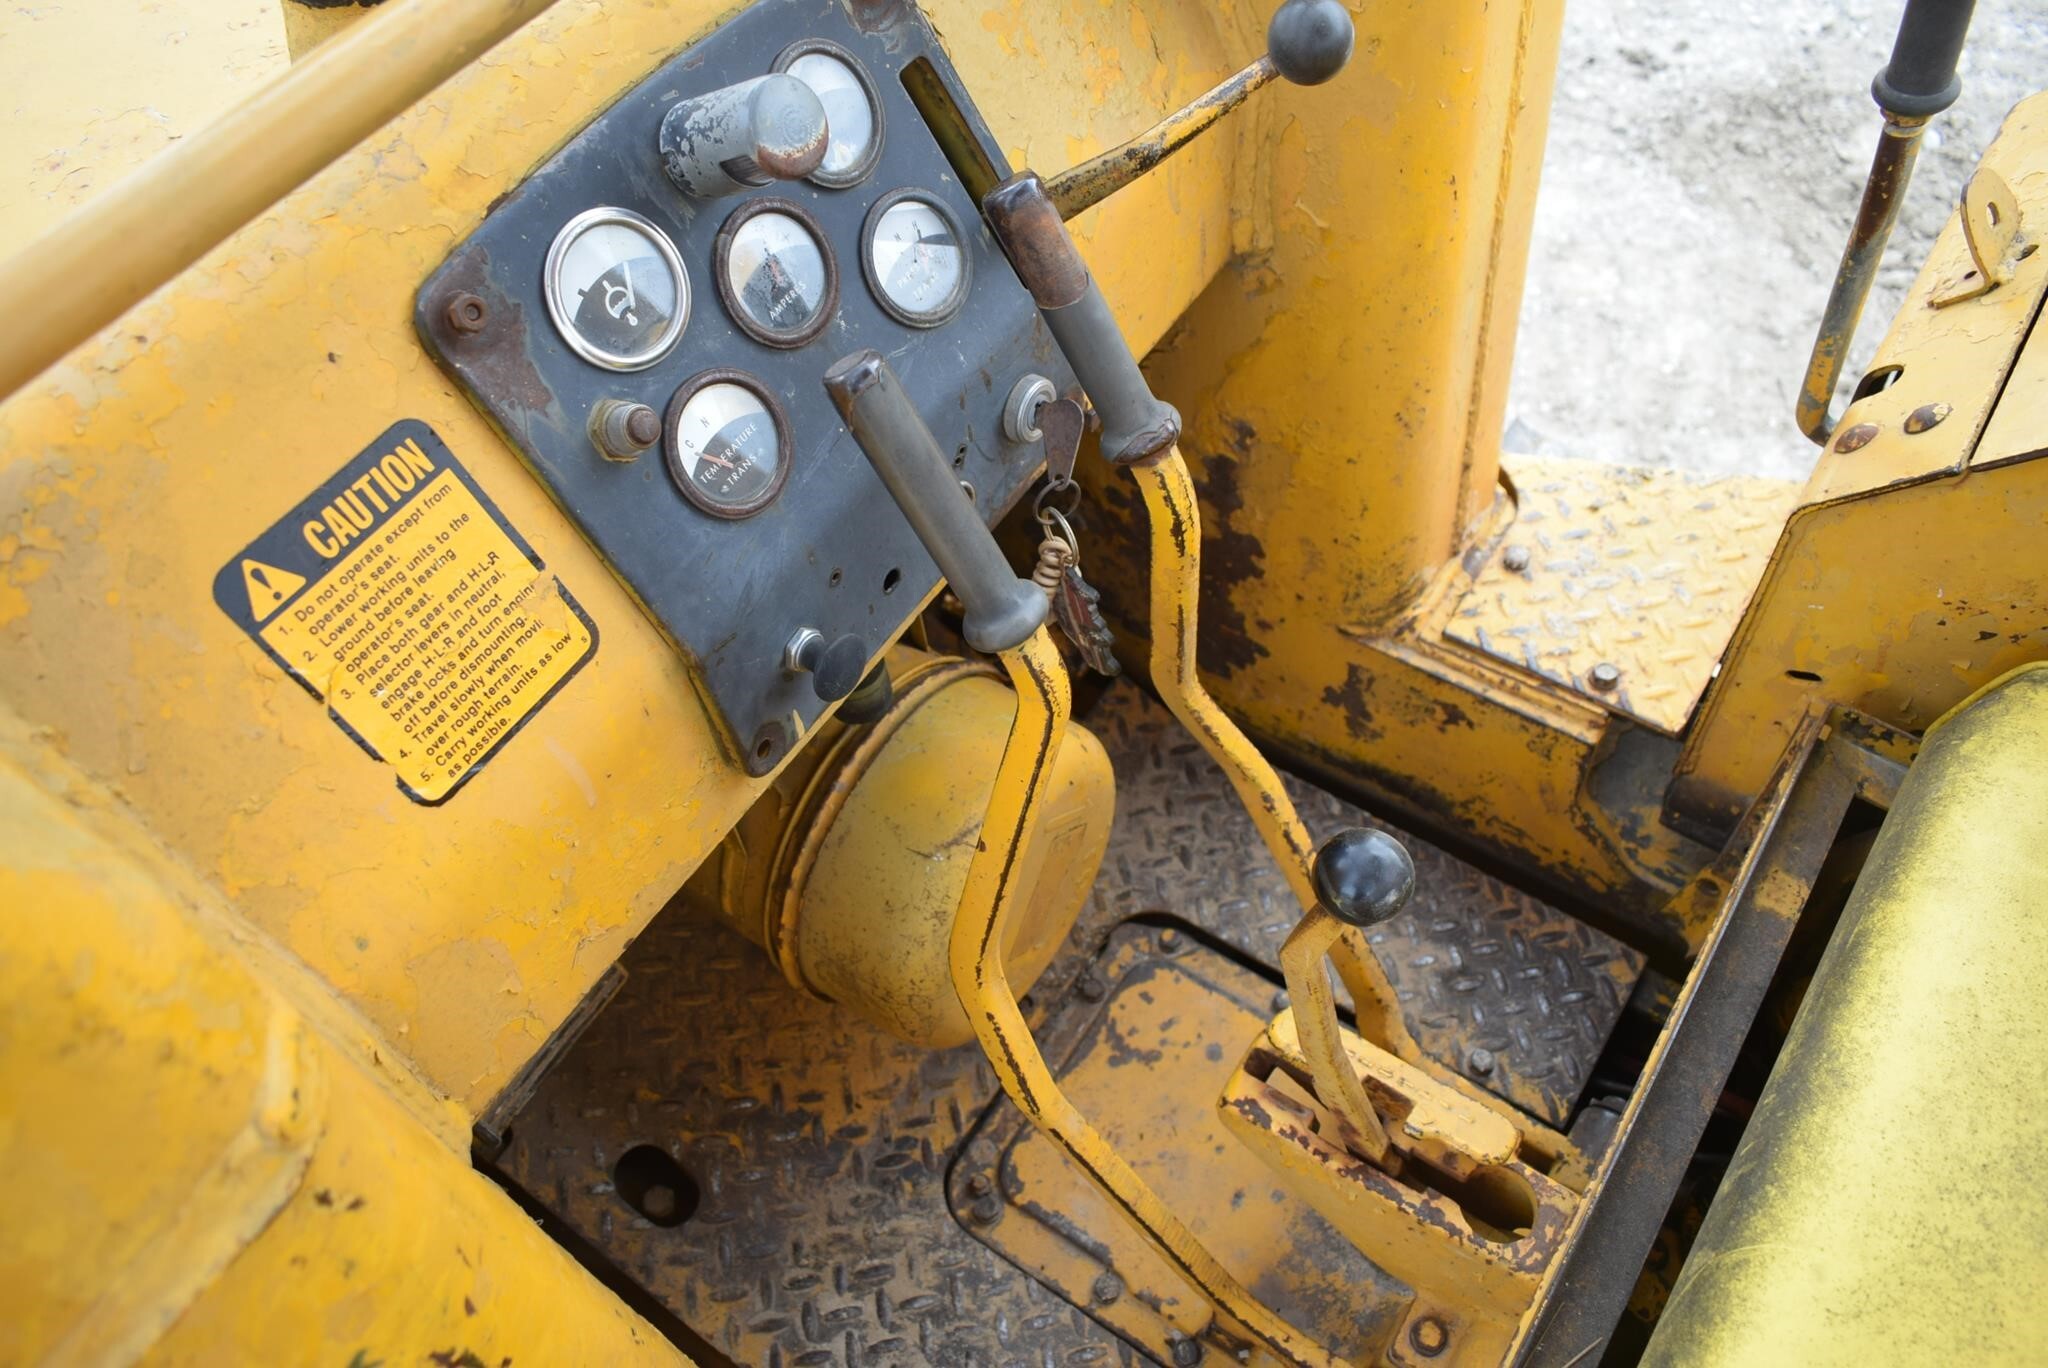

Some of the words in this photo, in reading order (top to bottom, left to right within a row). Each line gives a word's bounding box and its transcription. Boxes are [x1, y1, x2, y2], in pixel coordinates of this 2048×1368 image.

[768, 280, 807, 320] AMPERES
[684, 439, 694, 448] C
[700, 415, 710, 428] N
[726, 453, 757, 486] TRANS
[302, 438, 435, 559] CAUTION
[278, 625, 293, 635] 1.
[293, 605, 315, 622] Do
[315, 583, 338, 605] not
[338, 543, 384, 585] operate
[384, 506, 424, 544] except
[422, 484, 451, 509] from
[302, 650, 317, 662] 2.
[318, 612, 357, 647] Lower
[358, 570, 407, 613] working
[405, 543, 435, 571] units
[434, 531, 450, 544] to
[448, 512, 469, 531] the
[308, 580, 369, 635] operator's
[369, 554, 400, 581] seat.
[333, 618, 375, 662] ground
[373, 586, 413, 622] before
[411, 548, 456, 587] leaving
[340, 688, 355, 699] 3.
[355, 653, 390, 685] Place
[387, 627, 418, 654] both
[418, 601, 445, 630] gear
[446, 578, 468, 603] and
[345, 618, 403, 673] operator's
[404, 592, 434, 618] seat.
[368, 652, 414, 697] selector
[412, 620, 450, 654] levers
[447, 608, 463, 621] in
[463, 569, 506, 609] neutral,
[380, 669, 422, 709] engage
[455, 614, 478, 638] and
[476, 592, 502, 617] foot
[389, 690, 424, 722] brake
[422, 660, 456, 690] locks
[457, 635, 479, 661] and
[477, 615, 502, 639] turn
[502, 581, 535, 616] engin
[399, 748, 412, 759] 4.
[411, 708, 449, 743] Travel
[449, 675, 485, 711] slowly
[484, 646, 515, 675] when
[514, 619, 544, 647] movi
[403, 713, 421, 733] off
[419, 680, 458, 716] before
[458, 616, 527, 680] dismounting.
[419, 770, 434, 781] 5.
[435, 736, 467, 766] Carry
[466, 693, 511, 736] working
[510, 666, 538, 694] units
[538, 652, 552, 667] as
[550, 632, 571, 653] low
[425, 730, 449, 756] over
[450, 699, 484, 732] rough
[482, 663, 523, 699] terrain.
[447, 762, 462, 778] as
[461, 717, 511, 765] possible.
